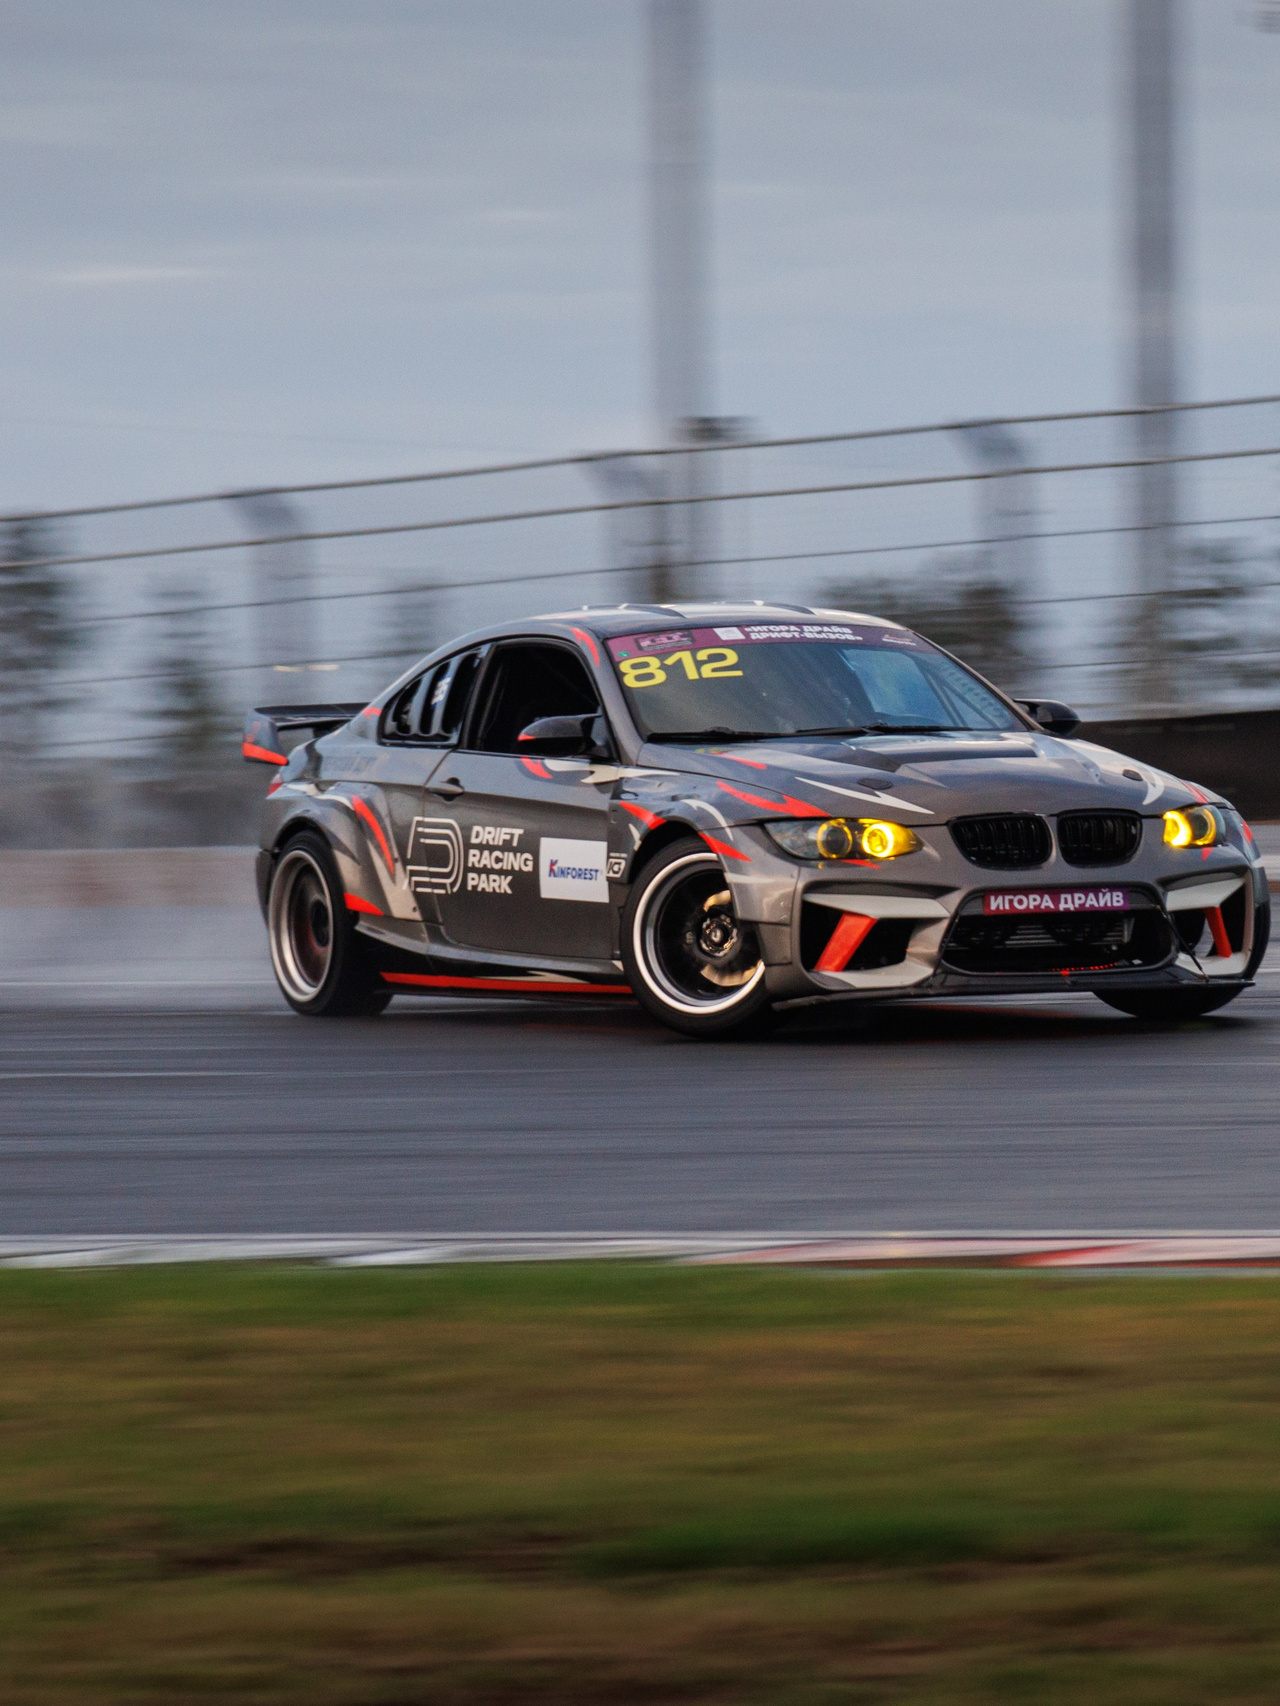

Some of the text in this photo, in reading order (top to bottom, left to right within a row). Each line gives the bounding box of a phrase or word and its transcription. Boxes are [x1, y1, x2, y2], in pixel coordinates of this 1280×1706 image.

[803, 625, 853, 634] ДРАЙВ
[618, 647, 744, 688] 812
[470, 825, 524, 847] DRIFT
[467, 849, 534, 872] RACING
[548, 859, 600, 881] KINFOREST
[467, 872, 513, 895] PARK
[989, 888, 1124, 911] ИГОРА ДРАЙВ
